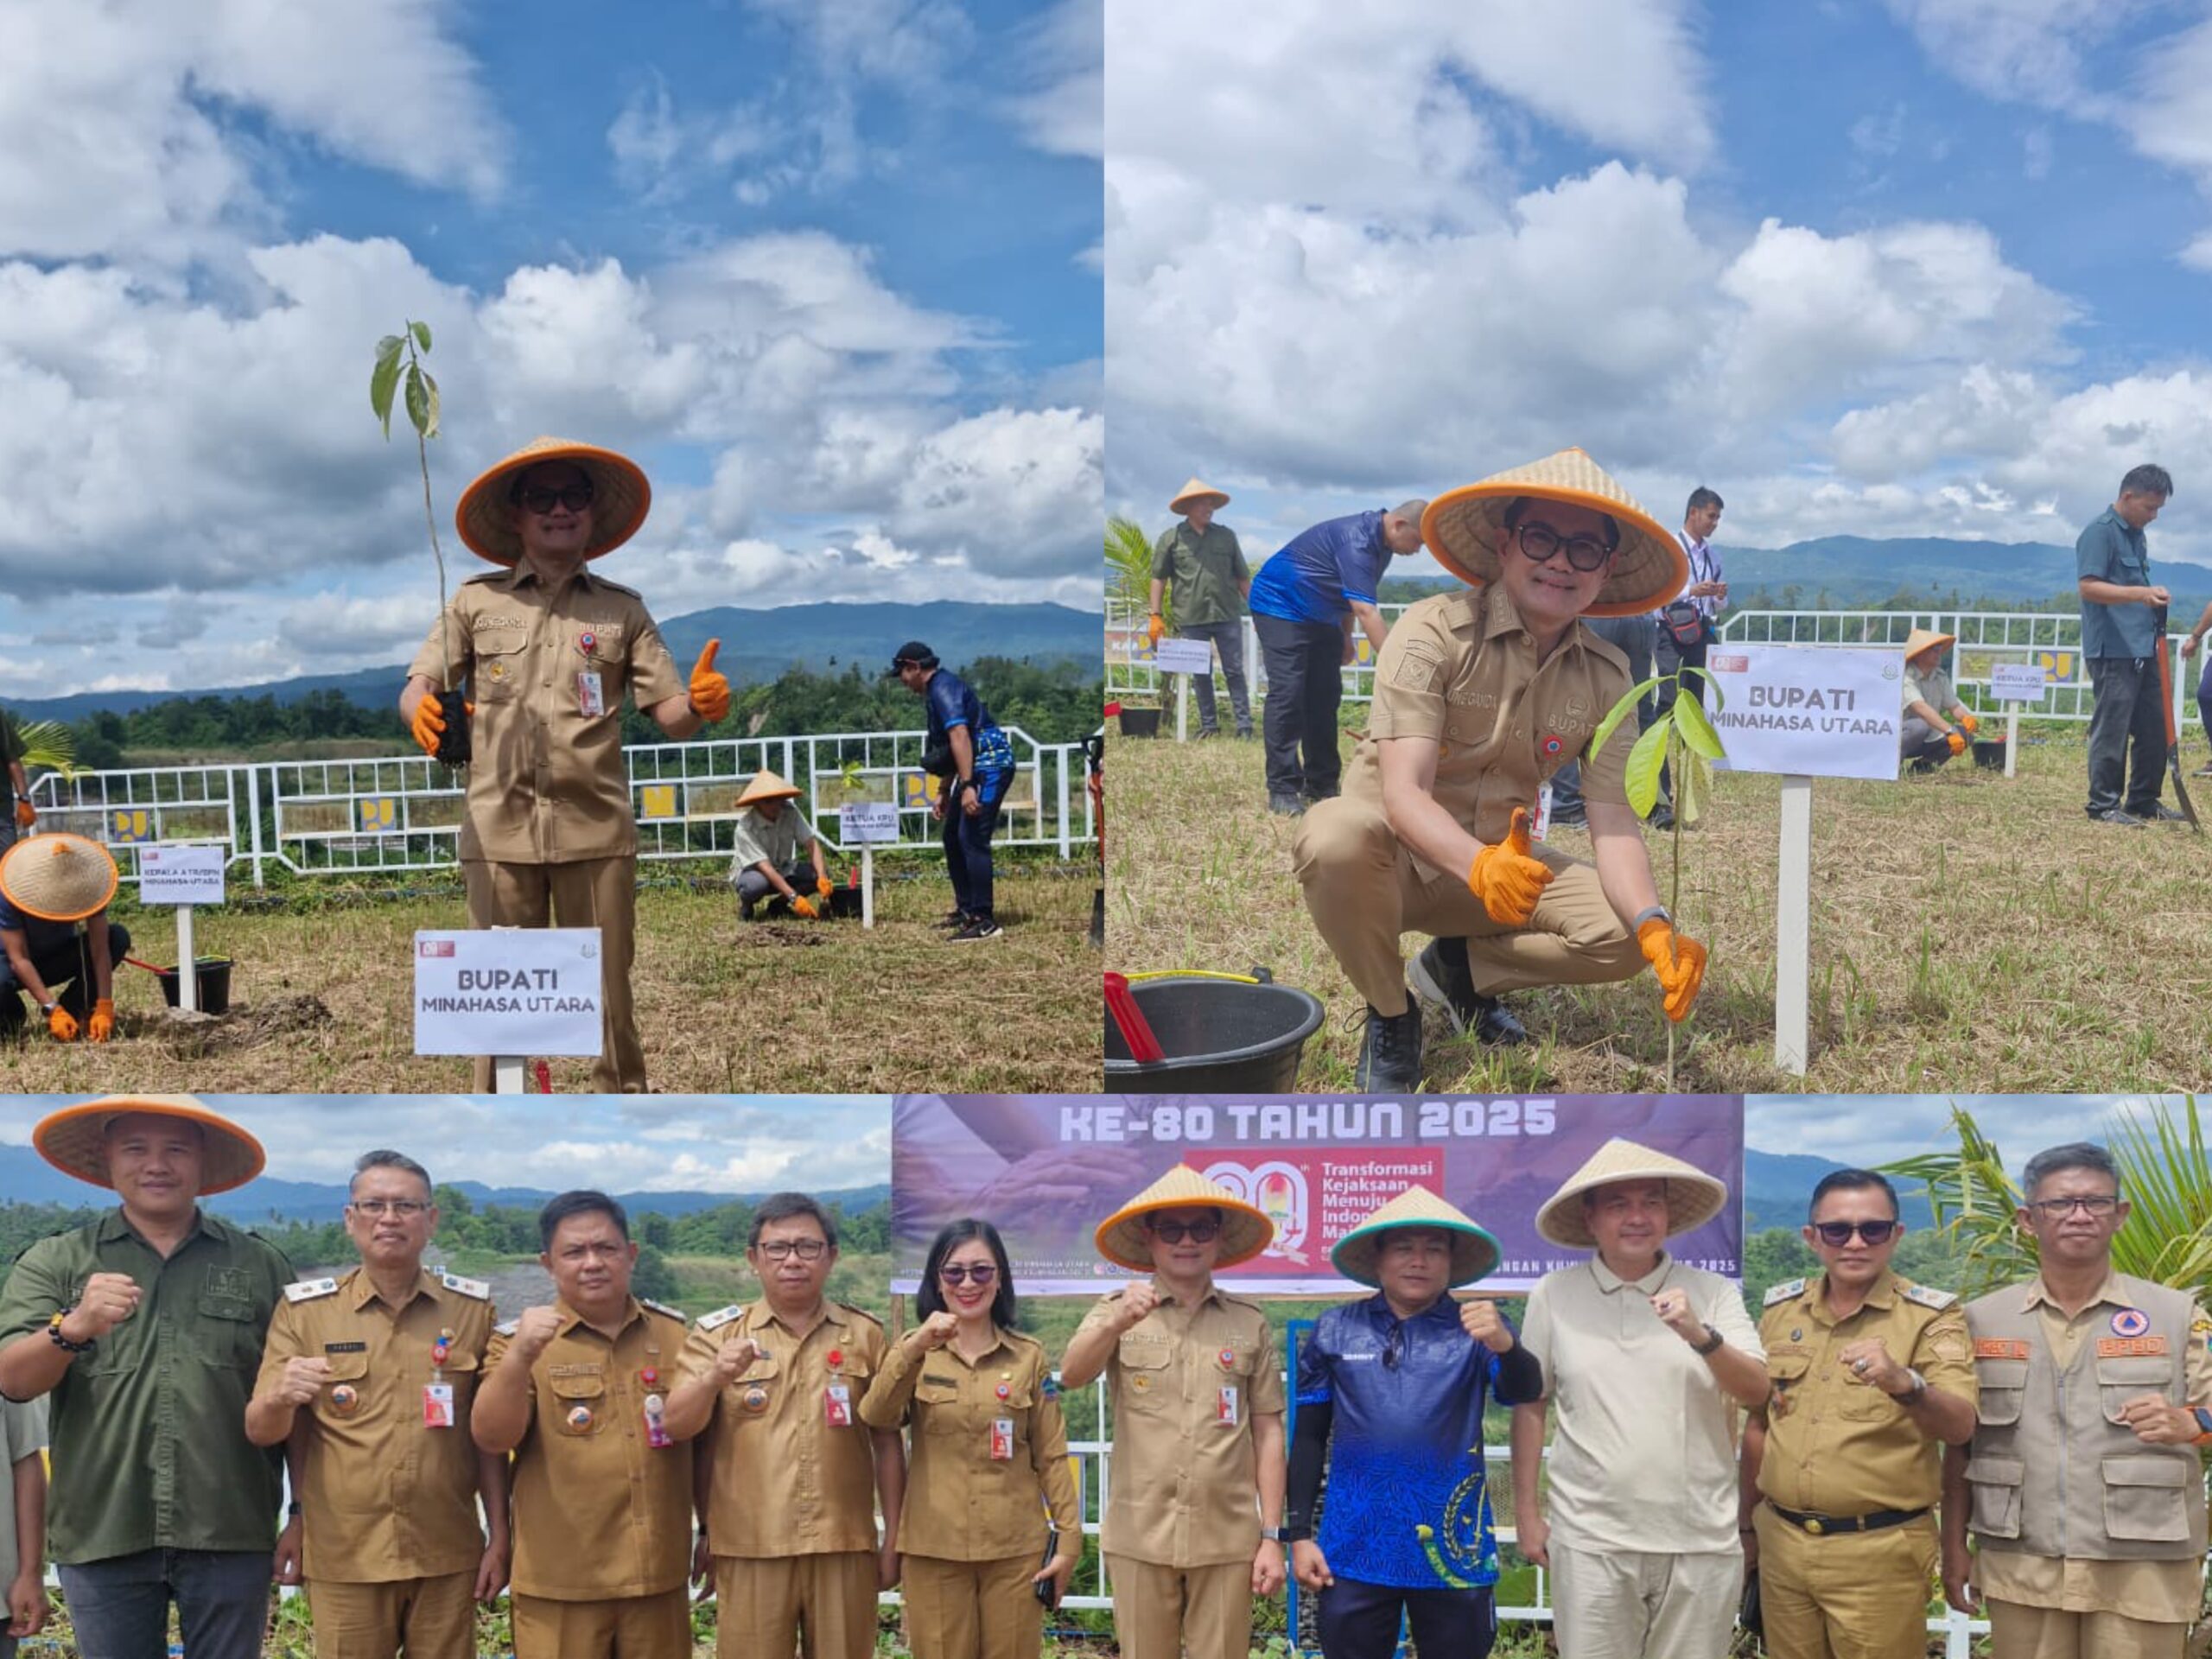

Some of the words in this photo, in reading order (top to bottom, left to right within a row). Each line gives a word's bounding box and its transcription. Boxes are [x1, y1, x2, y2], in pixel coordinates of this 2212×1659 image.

[1749, 685, 1855, 711] BUPATI
[1710, 713, 1815, 732] MINAHASA
[1821, 717, 1893, 735] UTARA
[458, 969, 557, 991] BUPATI
[422, 997, 522, 1012] MINAHASA
[527, 997, 594, 1012] UTARA
[1059, 1106, 1214, 1141] KE-80
[1228, 1103, 1403, 1140] TAHUN
[1419, 1099, 1556, 1136] 2025
[1321, 1160, 1433, 1176] Transformasi
[1322, 1178, 1408, 1194] Kejaksaan
[1322, 1193, 1386, 1210] Menuju
